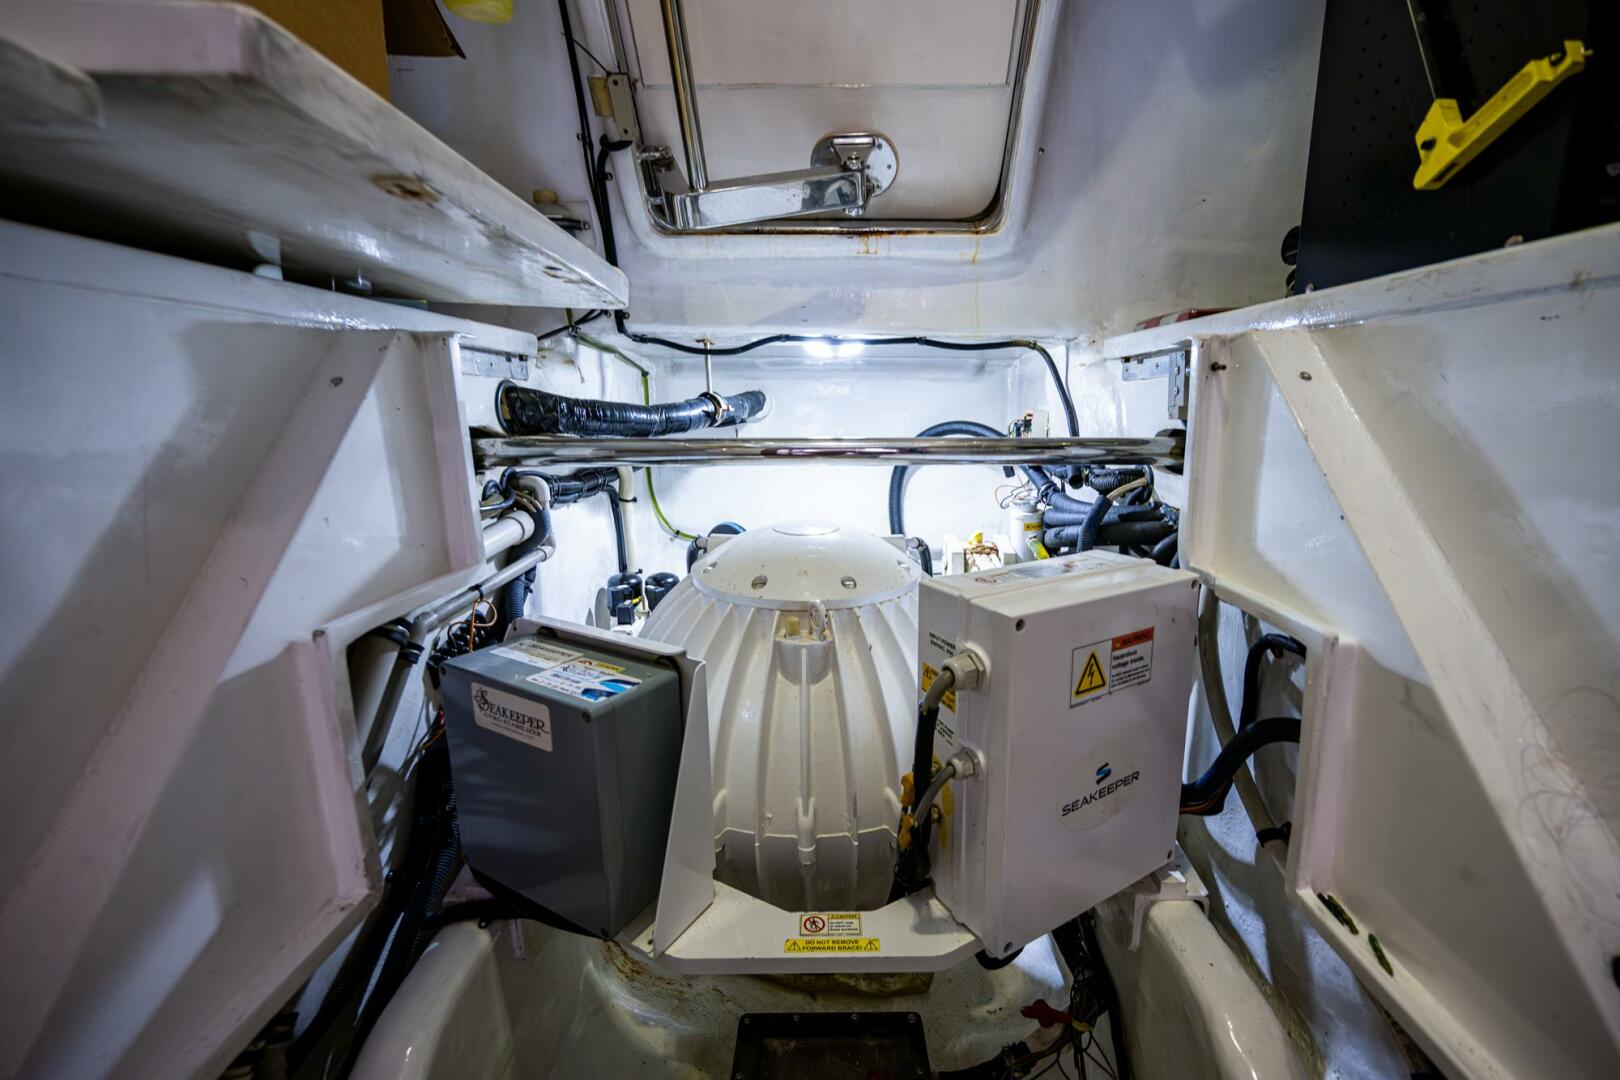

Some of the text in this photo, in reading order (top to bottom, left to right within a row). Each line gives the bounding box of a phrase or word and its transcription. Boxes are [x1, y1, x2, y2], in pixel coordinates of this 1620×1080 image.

[940, 638, 956, 650] POWER
[1121, 630, 1153, 646] WARNING
[477, 689, 549, 734] SEAKEEPER
[503, 719, 543, 737] STABILIZER
[1062, 770, 1140, 817] SEAKEEPER
